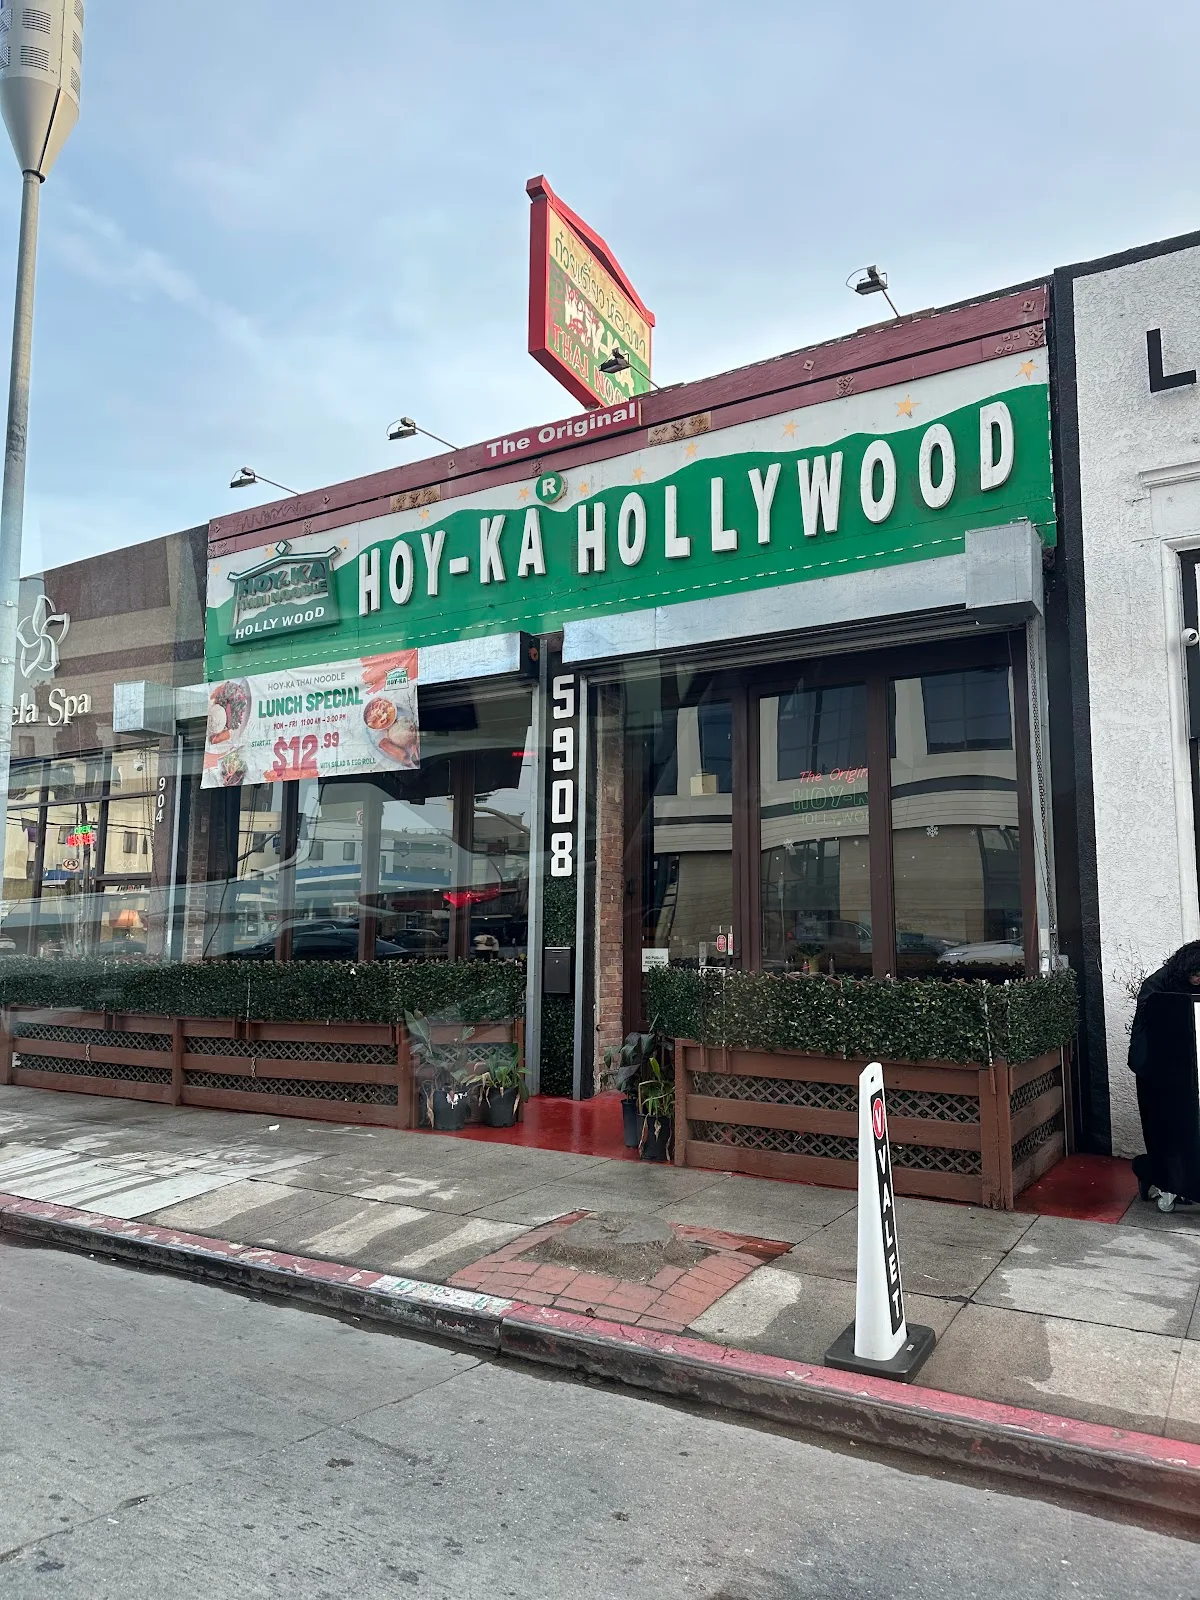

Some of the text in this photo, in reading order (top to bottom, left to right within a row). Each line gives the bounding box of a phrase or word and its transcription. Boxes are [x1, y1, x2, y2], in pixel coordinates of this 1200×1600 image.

[552, 323, 627, 406] THAI NOO
[1146, 328, 1197, 394] L
[487, 402, 636, 458] The Original
[542, 477, 557, 494] R
[358, 401, 1015, 616] HOY-KA HOLLYWOOD
[271, 580, 328, 603] NOODLE
[267, 672, 346, 691] HOY-KA THAI NOODLE
[47, 688, 93, 727] Spa
[258, 686, 364, 718] LUNCH SPECIAL
[273, 722, 284, 730] MON
[339, 713, 347, 721] PM
[331, 760, 346, 768] SALAD
[550, 674, 575, 877] 5908
[799, 770, 823, 784] The
[155, 776, 166, 823] 904
[877, 1144, 902, 1320] VALET
